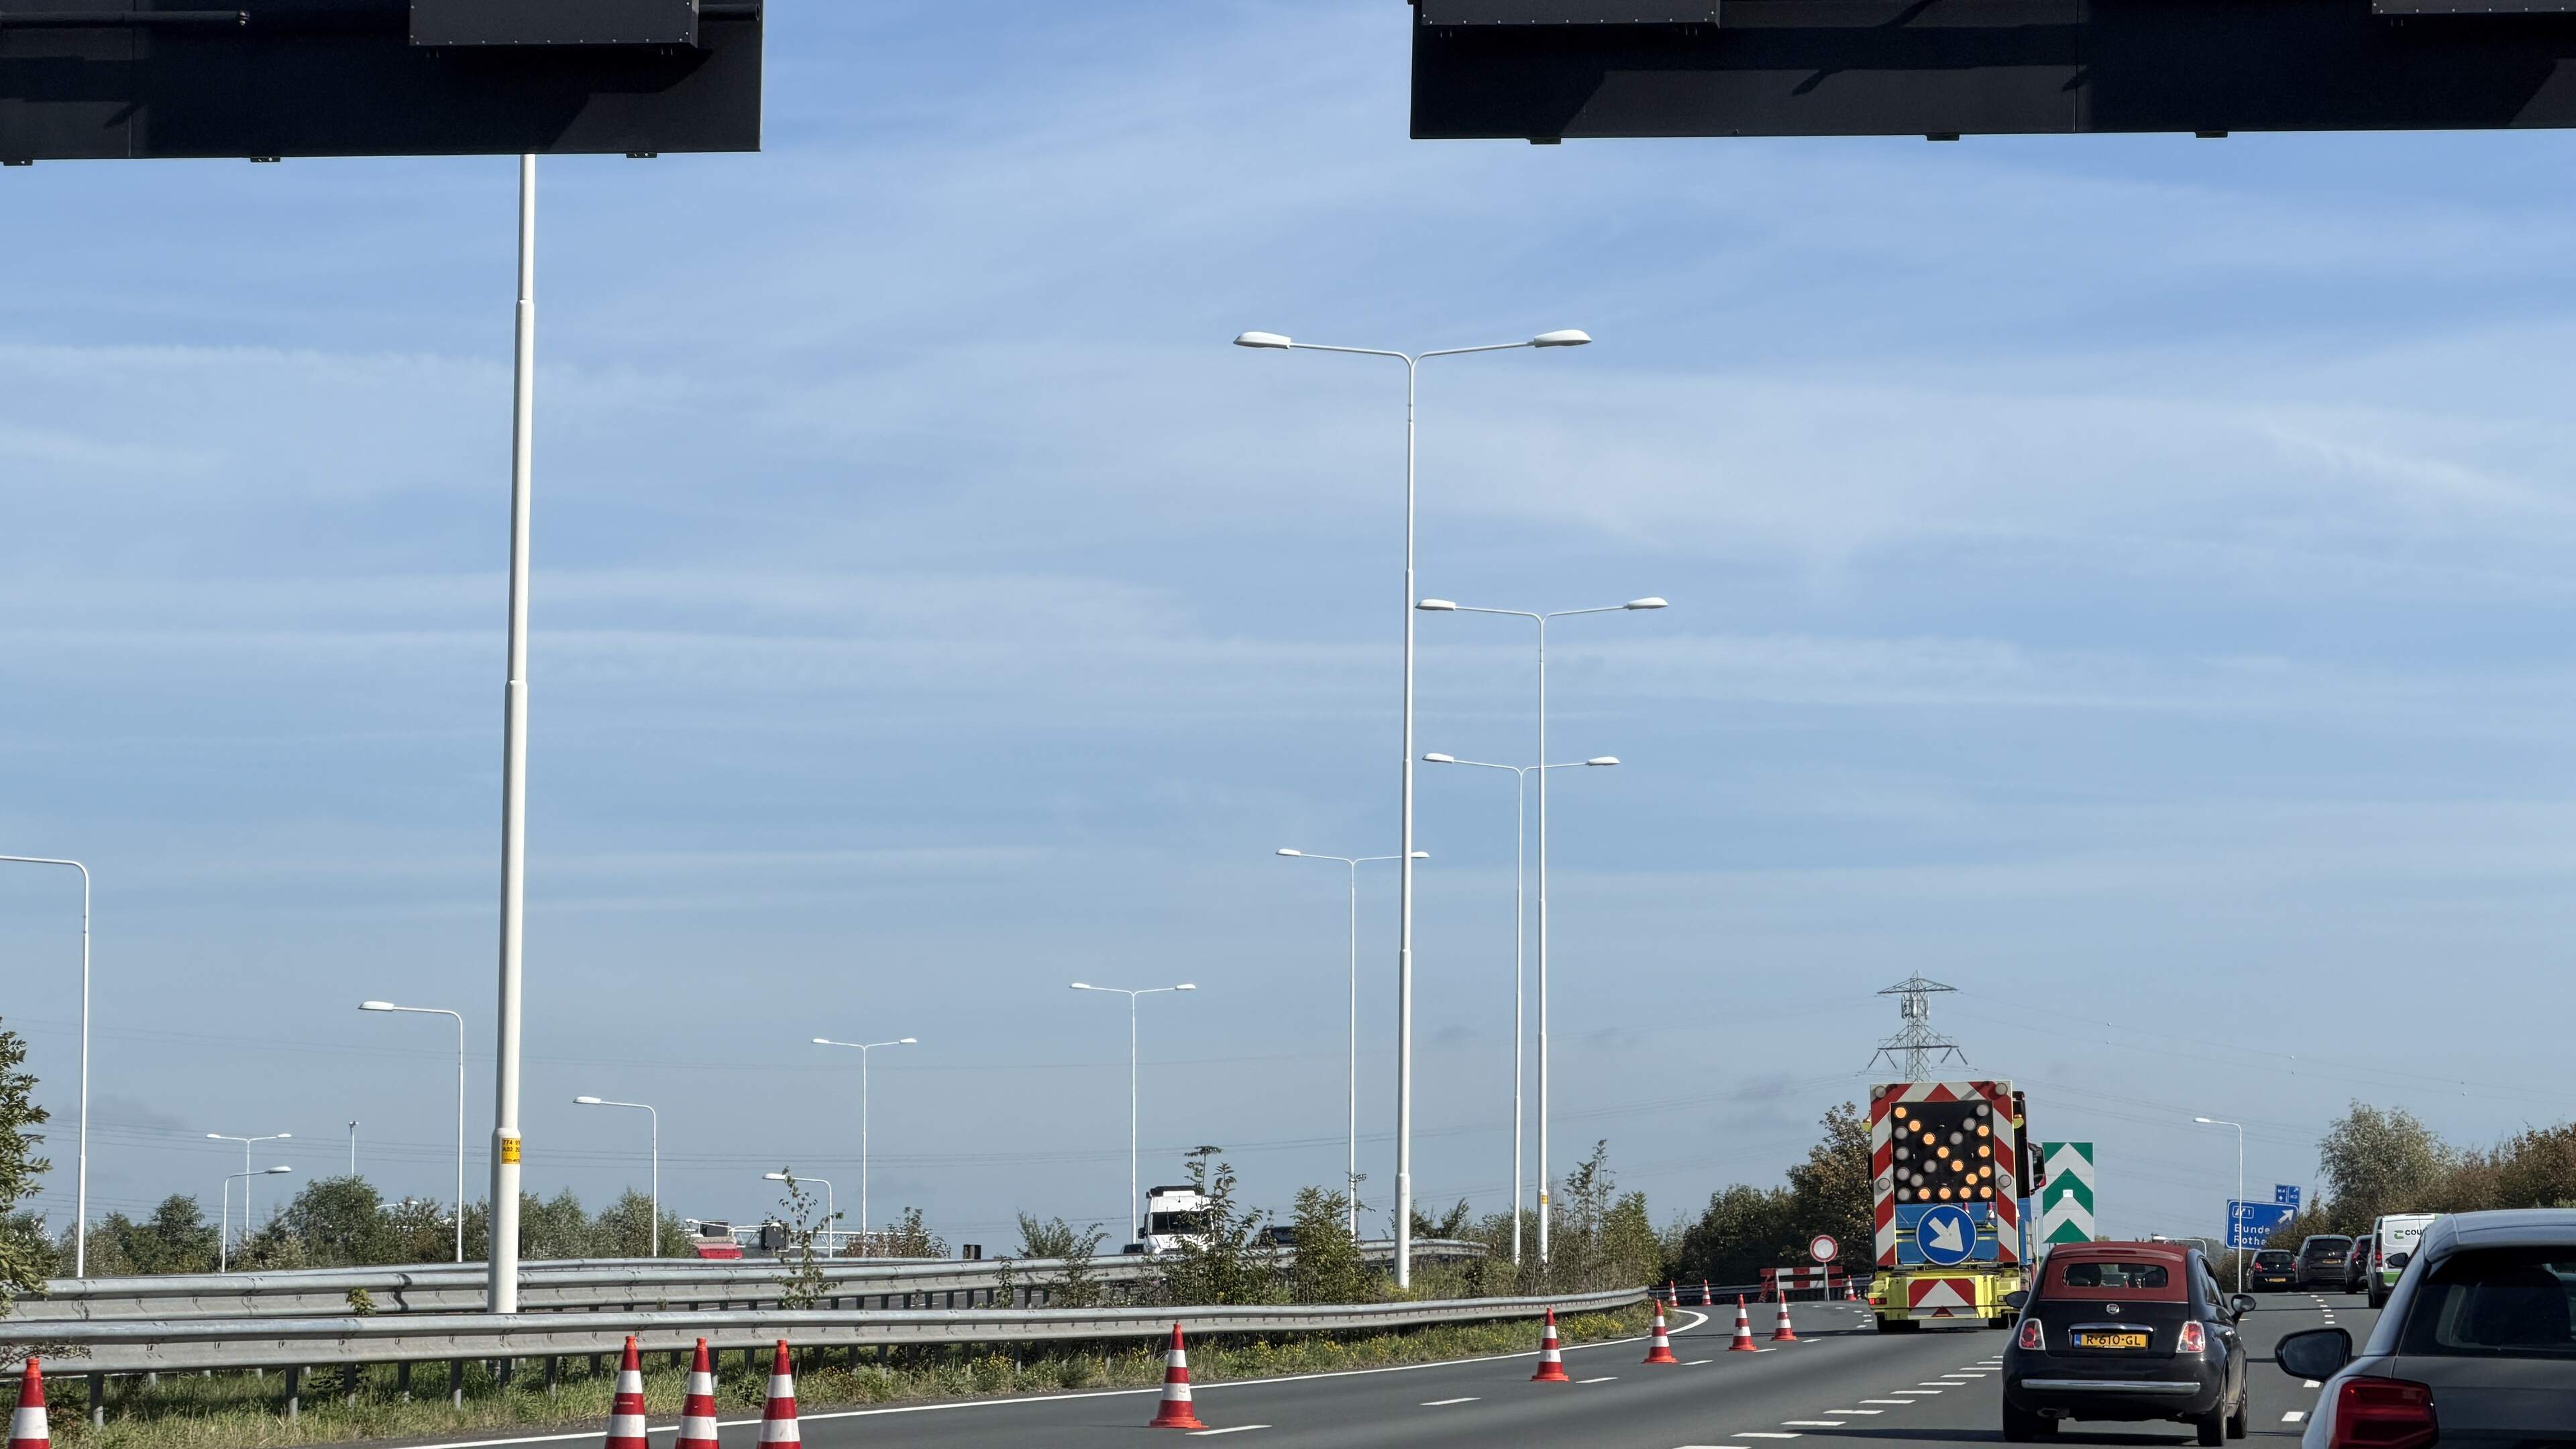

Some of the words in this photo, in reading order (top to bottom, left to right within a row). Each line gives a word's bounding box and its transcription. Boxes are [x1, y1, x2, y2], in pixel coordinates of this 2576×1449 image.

[2234, 1224, 2270, 1234] Bunde
[2234, 1235, 2267, 1245] Rothe
[2086, 1335, 2141, 1346] R-610-GL
